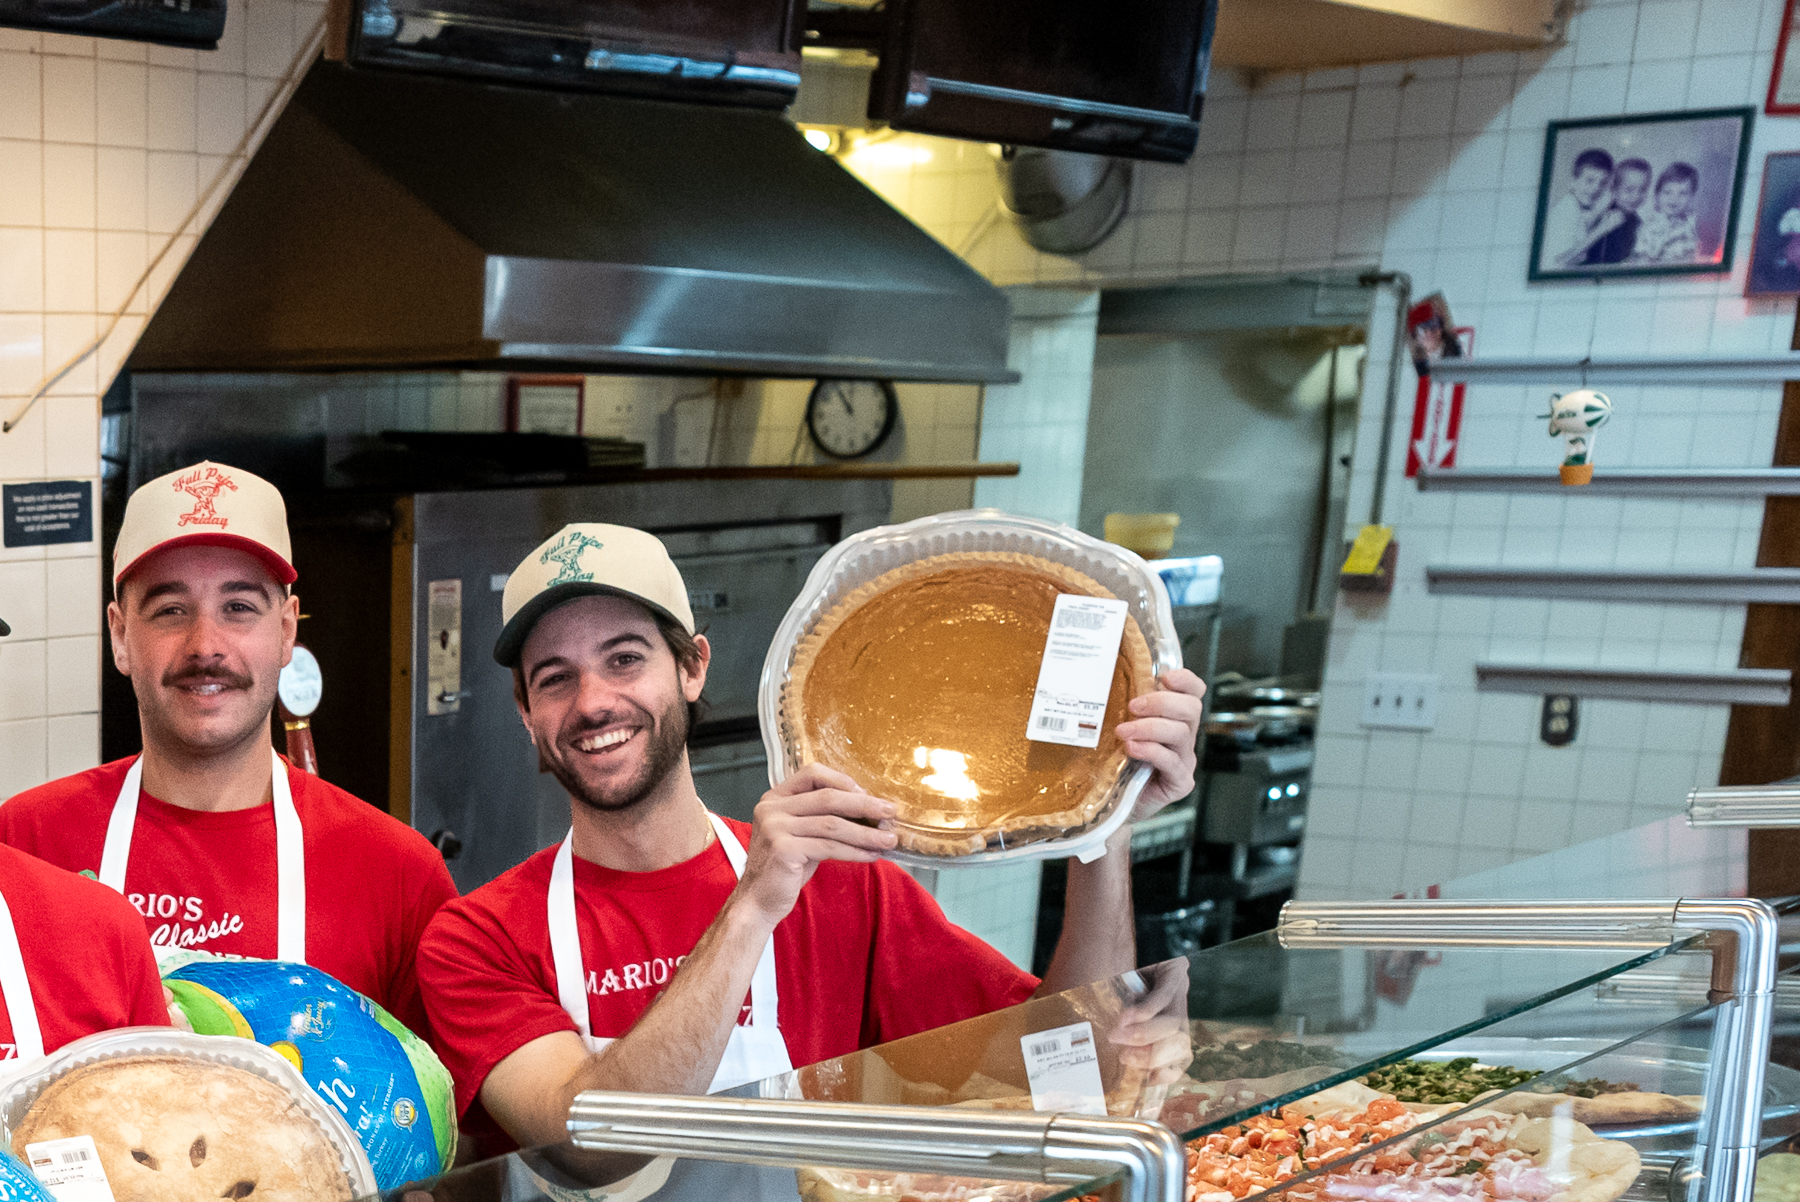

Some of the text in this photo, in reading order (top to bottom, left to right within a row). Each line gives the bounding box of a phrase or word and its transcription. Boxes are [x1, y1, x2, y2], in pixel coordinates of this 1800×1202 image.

[172, 467, 239, 493] Full Price
[177, 513, 229, 530] Friday
[149, 911, 244, 948] Classic
